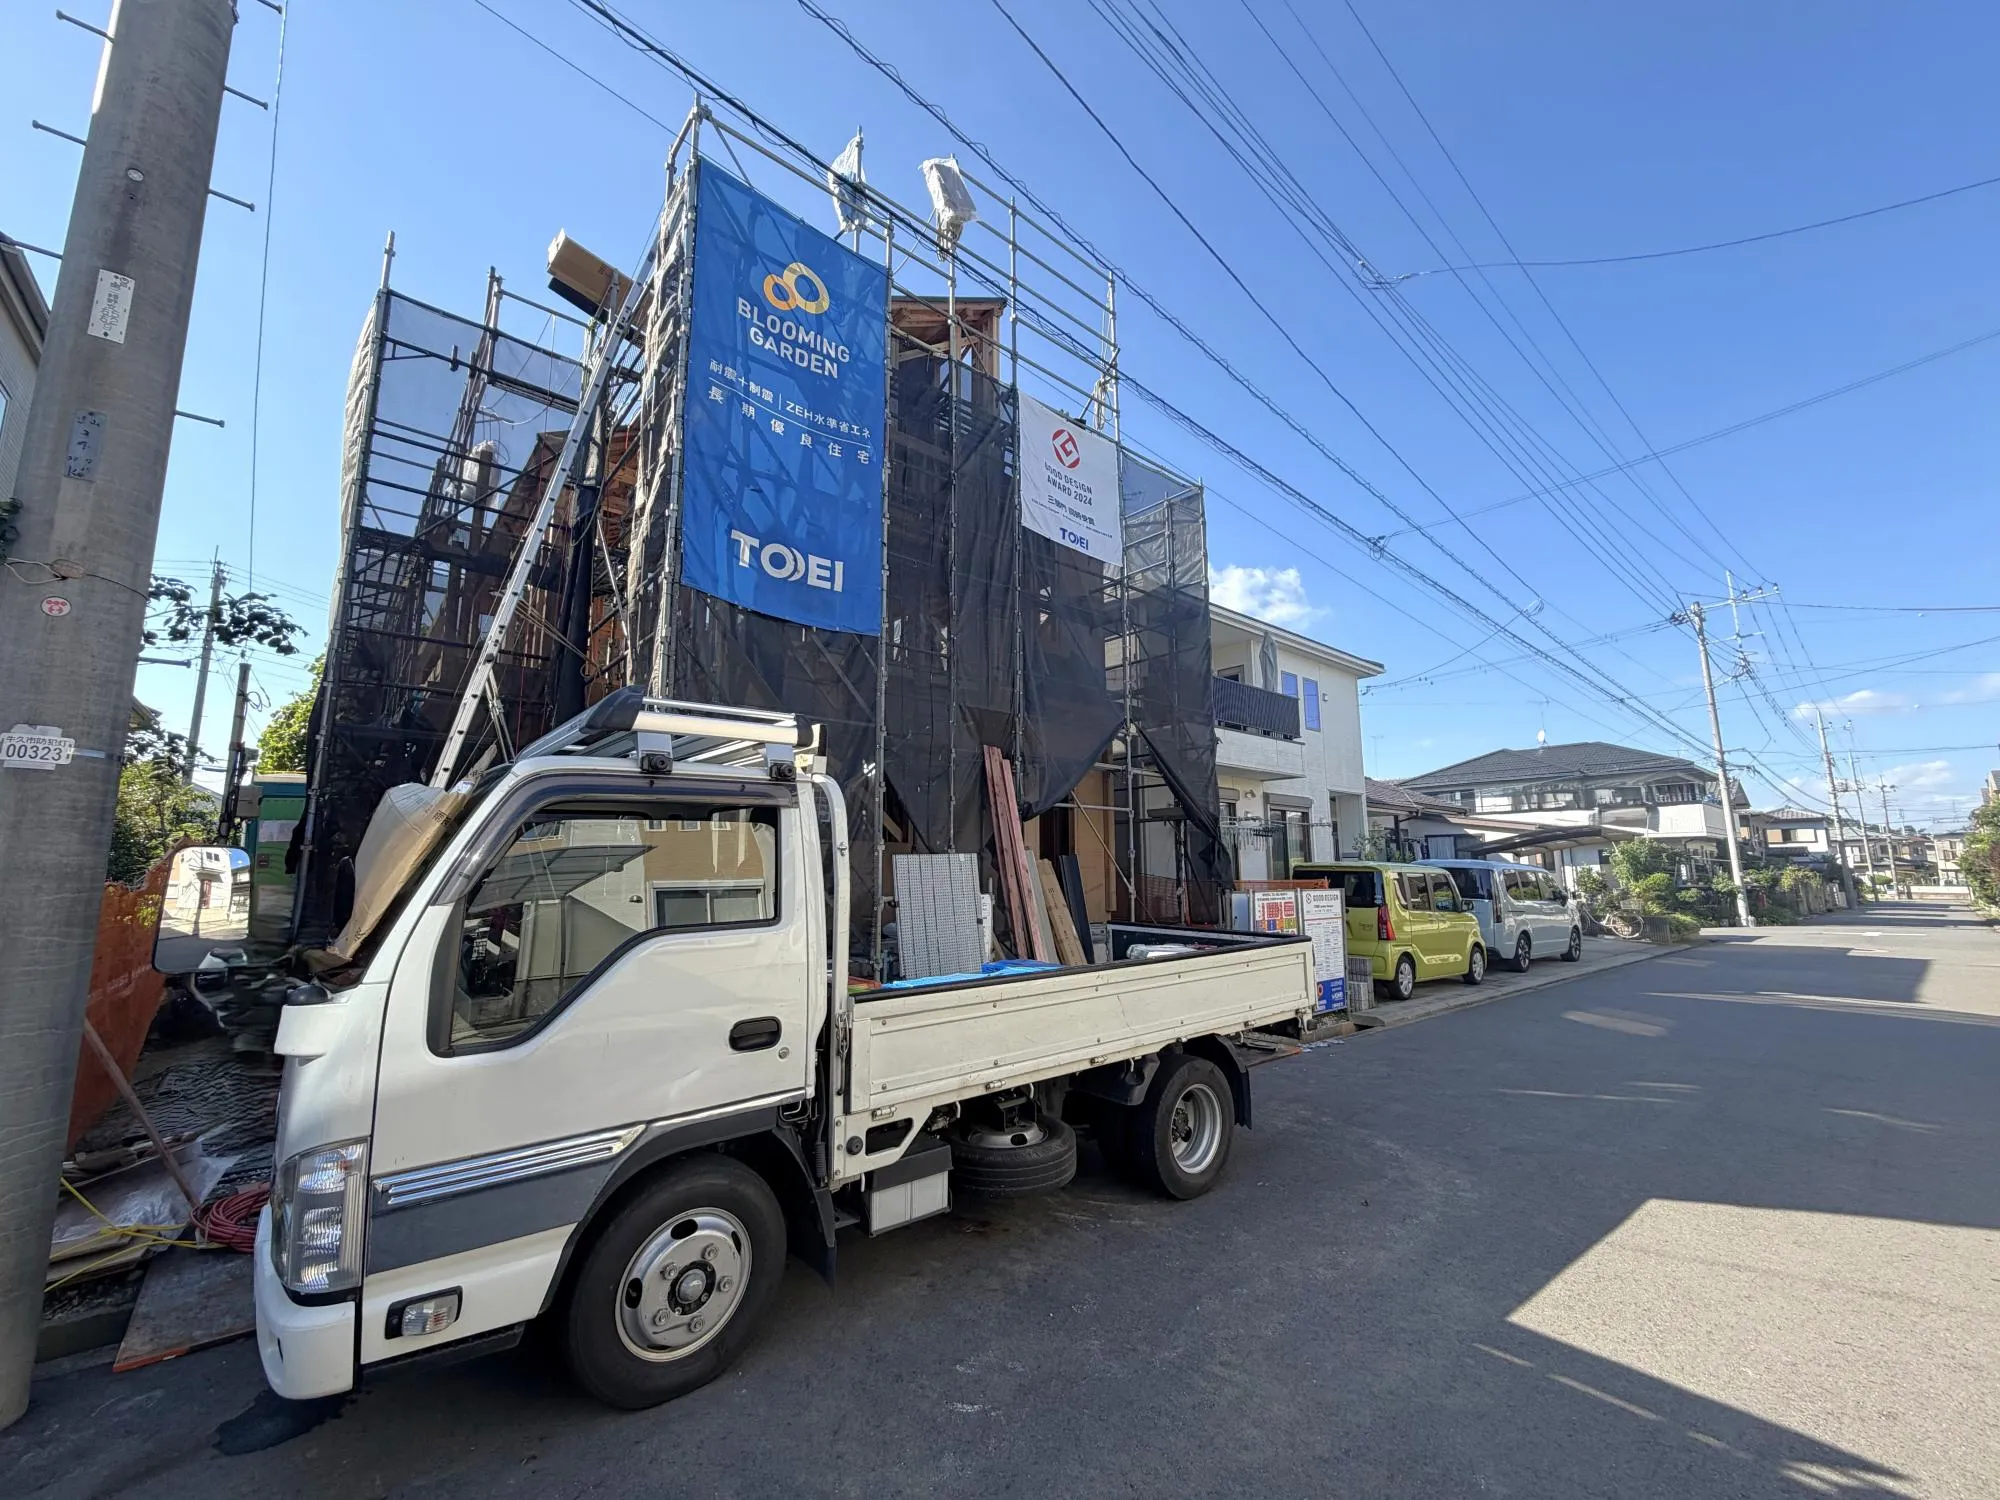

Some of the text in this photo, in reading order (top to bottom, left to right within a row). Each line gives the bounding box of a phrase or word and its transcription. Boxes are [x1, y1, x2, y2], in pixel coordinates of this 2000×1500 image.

[738, 297, 850, 363] BLOOMING
[750, 327, 838, 379] GARDEN
[708, 385, 870, 465] 長期優良住宅
[1047, 475, 1072, 497] AWARD
[1073, 490, 1093, 506] 2024
[1064, 475, 1093, 495] DESIGN
[6, 743, 63, 761] 00323
